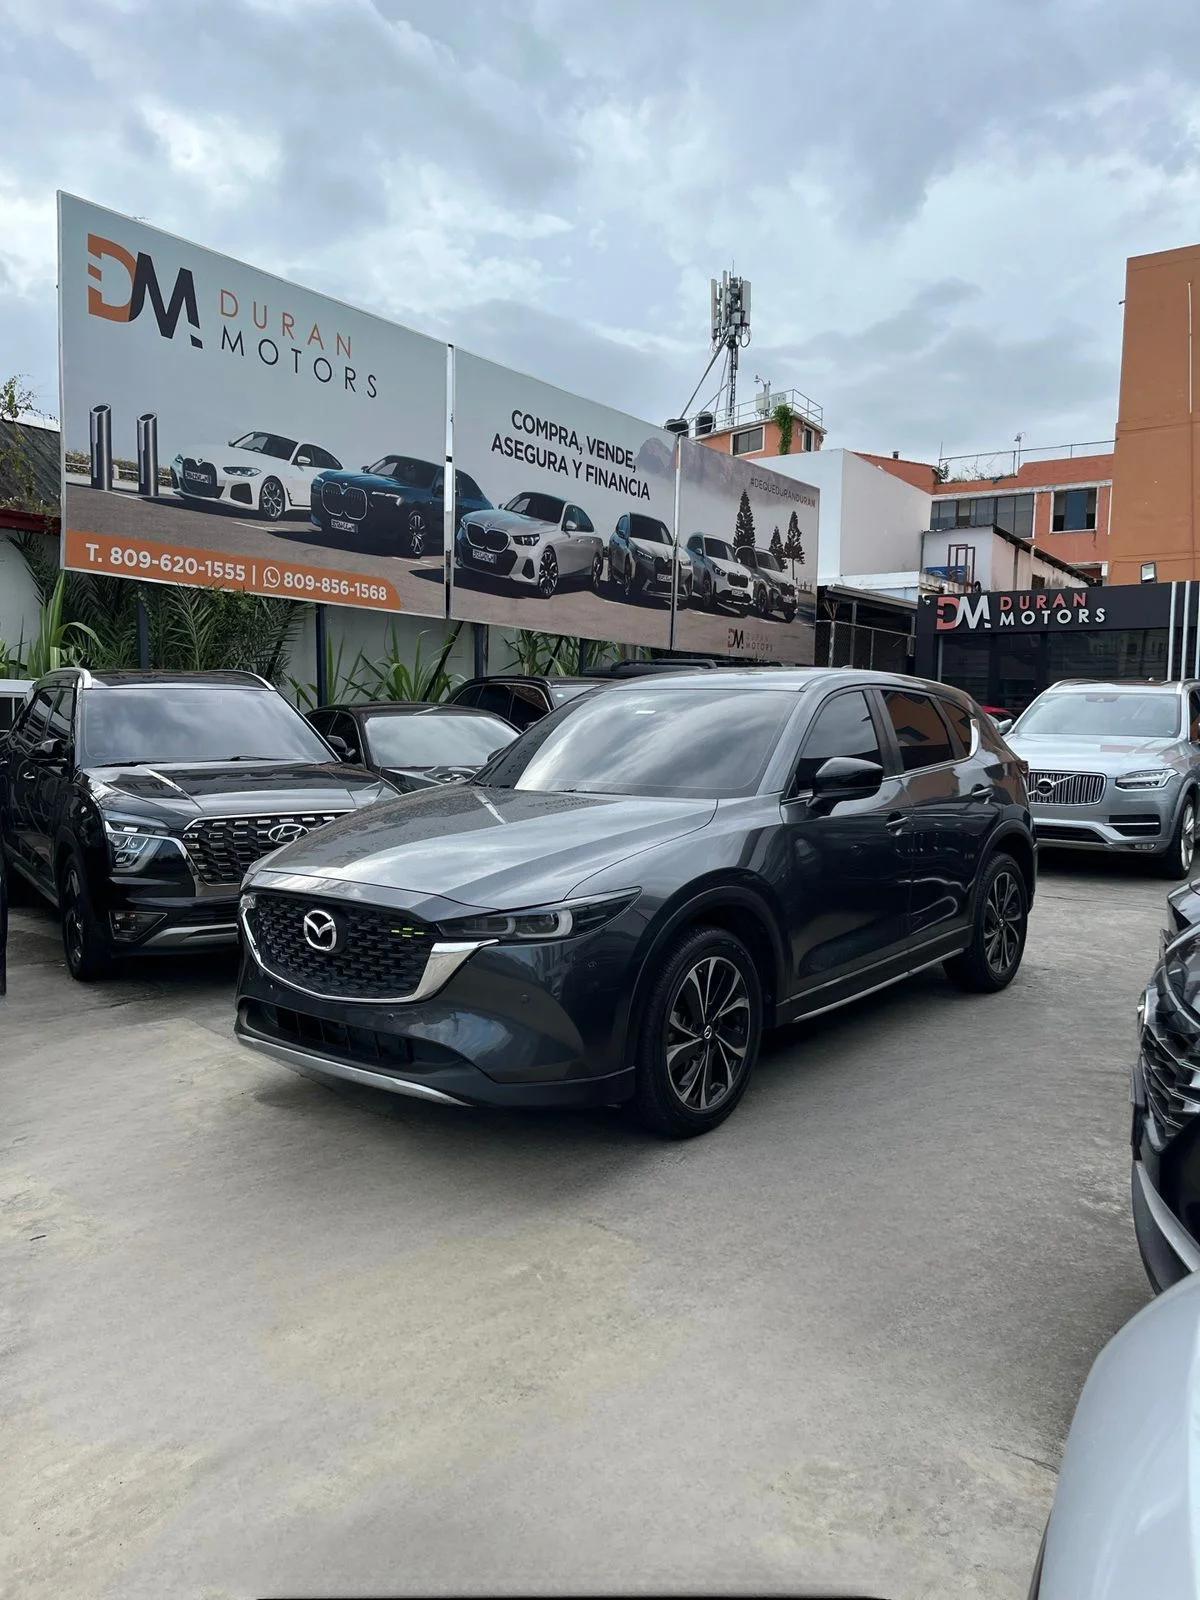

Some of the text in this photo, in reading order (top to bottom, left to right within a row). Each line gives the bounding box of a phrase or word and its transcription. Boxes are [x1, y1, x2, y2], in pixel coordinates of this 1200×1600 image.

[219, 288, 352, 360] DURAN
[220, 325, 377, 399] MOTORS
[491, 433, 651, 501] ASEGURA Y FINANCIA
[511, 409, 637, 473] COMPRA, VENDE,
[85, 542, 388, 601] T. 809-620-1555 809-856-1568
[999, 592, 1088, 611] DURAN
[999, 607, 1107, 627] MOTORS
